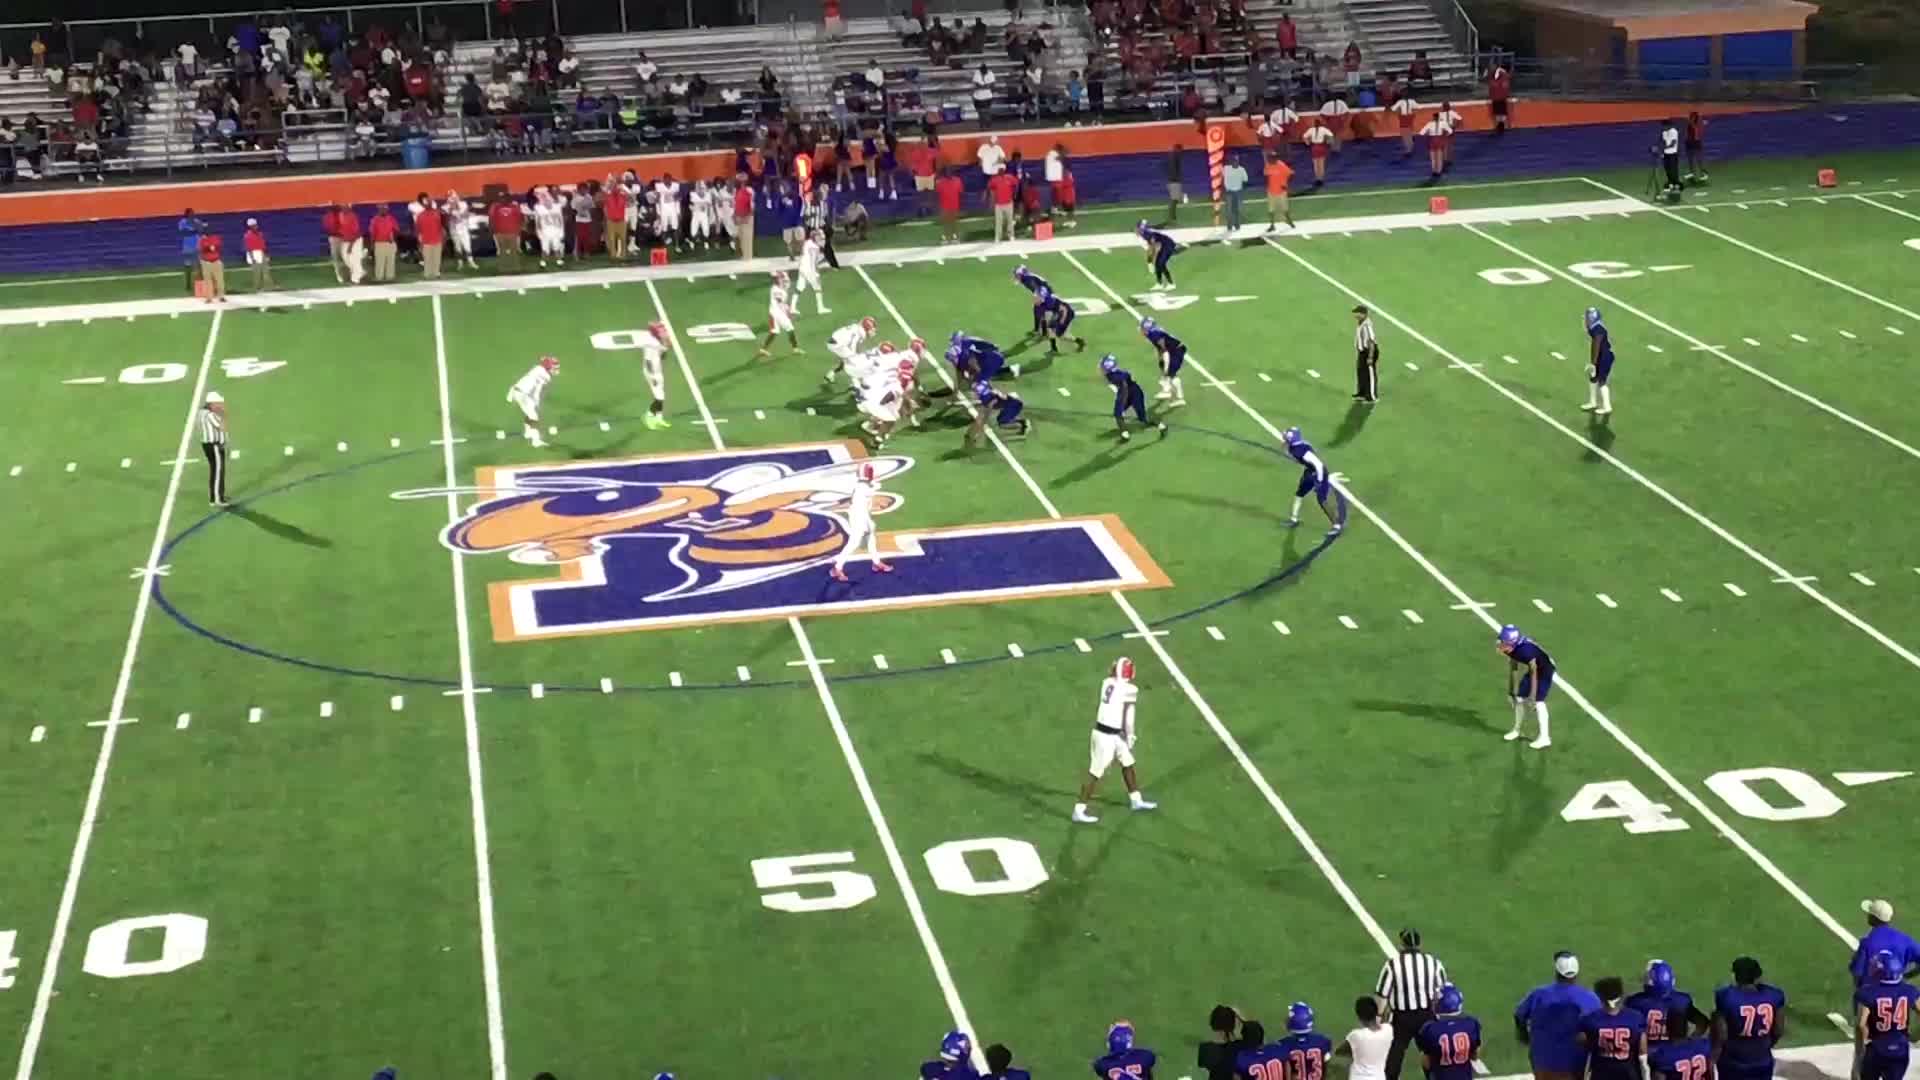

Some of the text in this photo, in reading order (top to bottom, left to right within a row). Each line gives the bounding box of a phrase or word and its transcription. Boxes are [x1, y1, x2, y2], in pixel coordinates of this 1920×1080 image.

[1103, 684, 1114, 704] 9
[1560, 767, 1848, 834] 40
[750, 837, 1050, 913] 50
[1740, 1002, 1774, 1037] 73
[1876, 996, 1909, 1032] 54
[1598, 1026, 1631, 1060] 55
